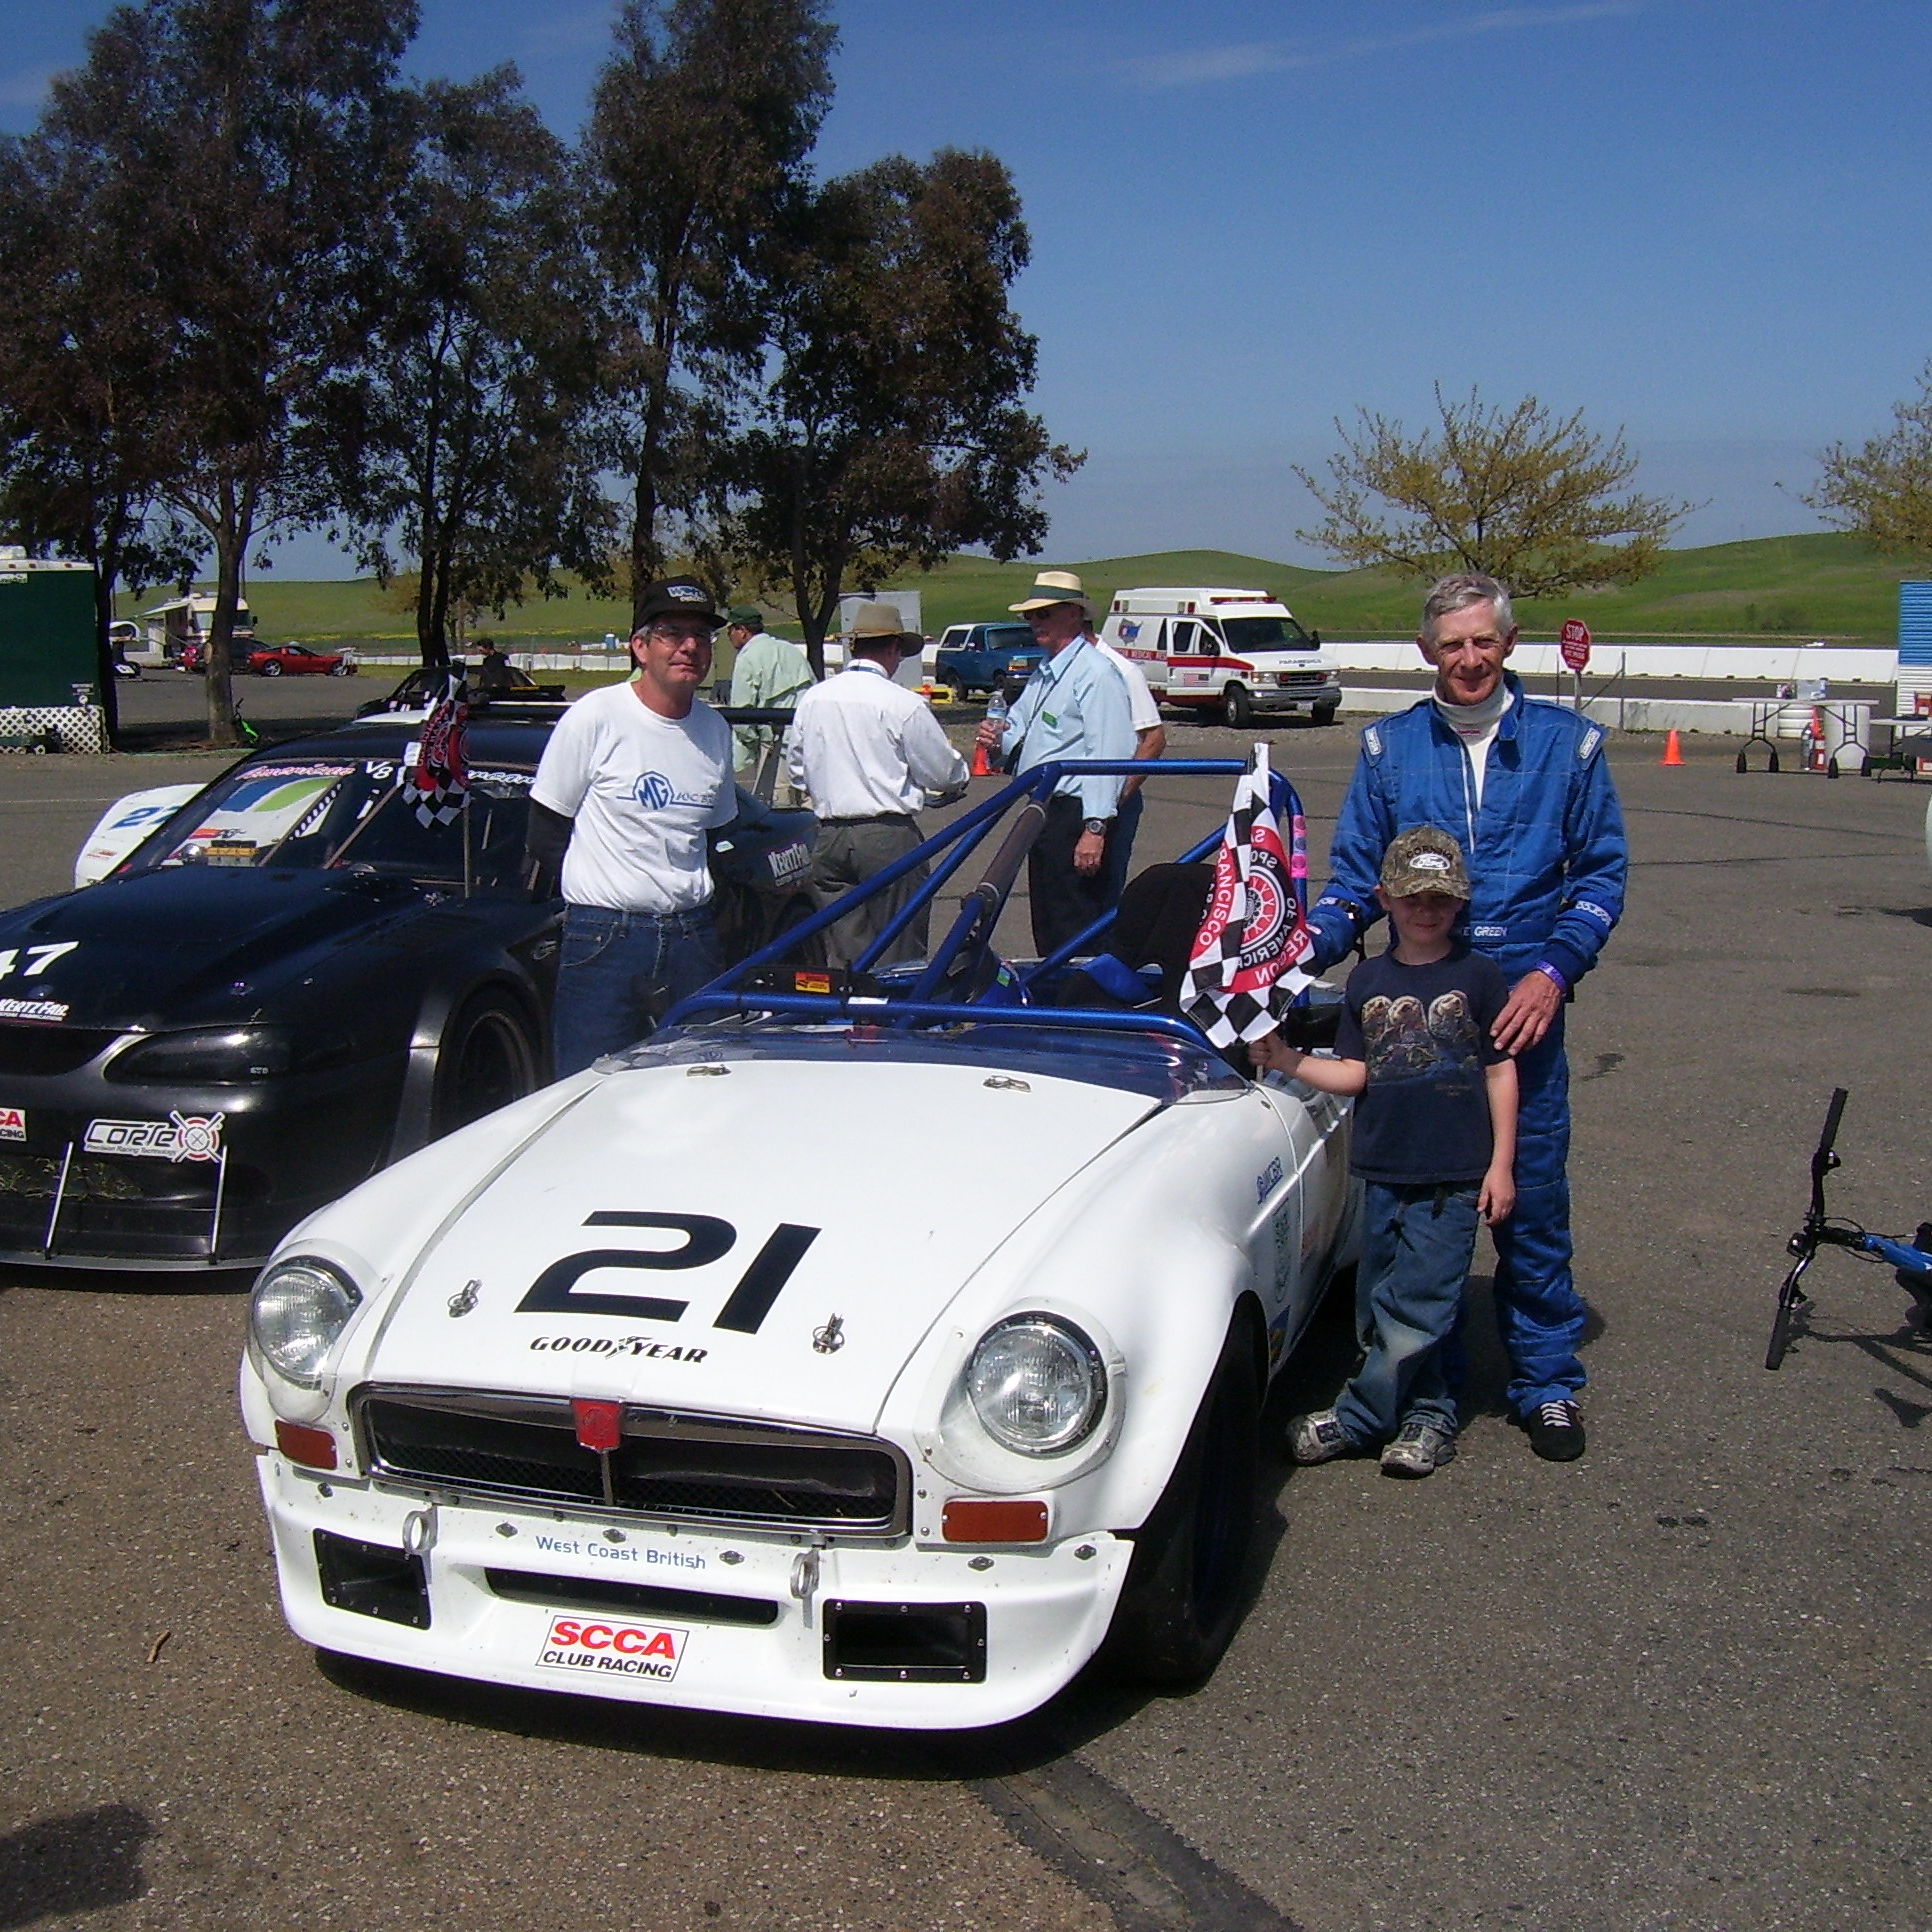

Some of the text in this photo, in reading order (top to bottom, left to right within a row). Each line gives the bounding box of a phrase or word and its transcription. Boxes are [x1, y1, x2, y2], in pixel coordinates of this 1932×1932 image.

[366, 761, 394, 779] V8
[637, 776, 669, 811] MG
[512, 1210, 822, 1335] 21
[529, 1335, 708, 1364] GOODYEAR
[536, 1536, 706, 1570] West Coast British
[550, 1621, 676, 1660] SCCA
[543, 1650, 673, 1679] CLUB RACING
